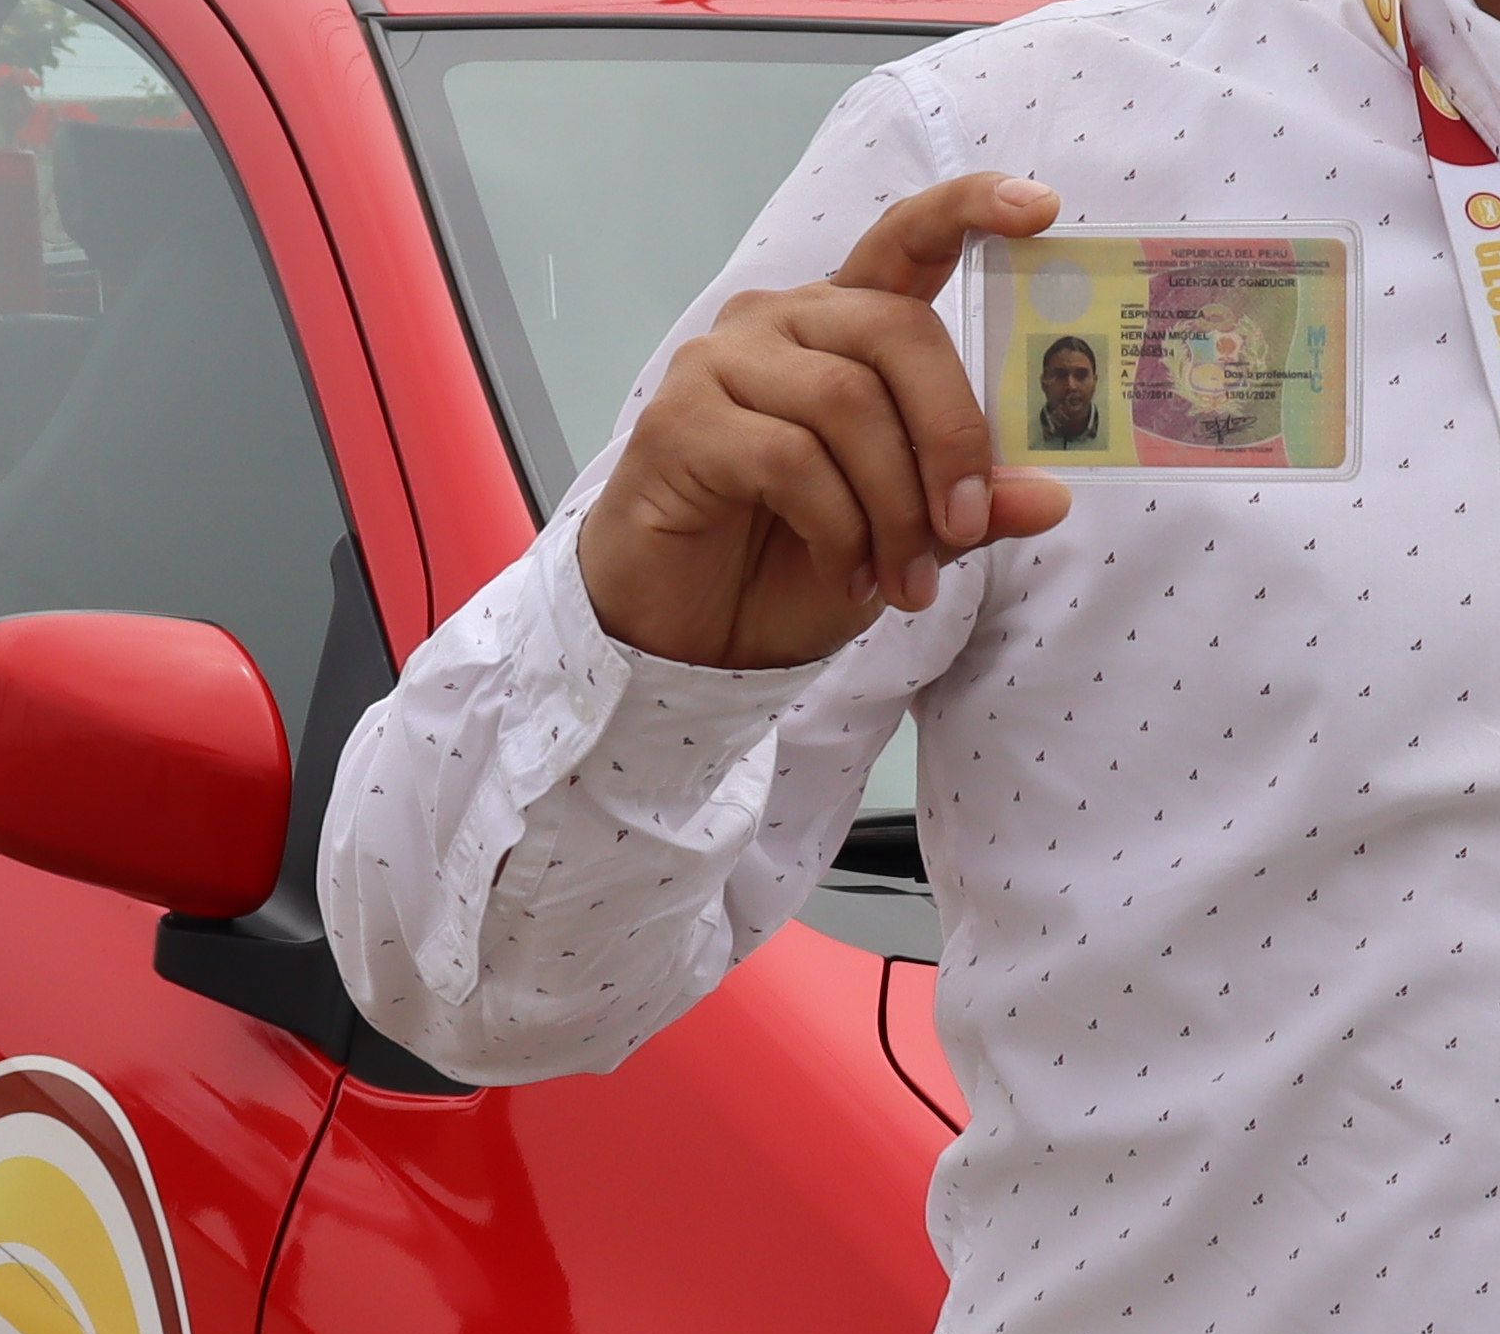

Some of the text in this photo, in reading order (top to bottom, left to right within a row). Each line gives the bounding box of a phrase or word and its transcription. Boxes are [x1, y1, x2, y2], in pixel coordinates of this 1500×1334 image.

[1171, 248, 1288, 259] REPUBLICA DEL PERU
[1169, 276, 1296, 288] LICENCIA DE CONDUCIR
[1168, 331, 1210, 342] MIGUEL
[1120, 369, 1129, 379] A
[1223, 370, 1244, 380] Dos
[1255, 369, 1313, 381] profesional
